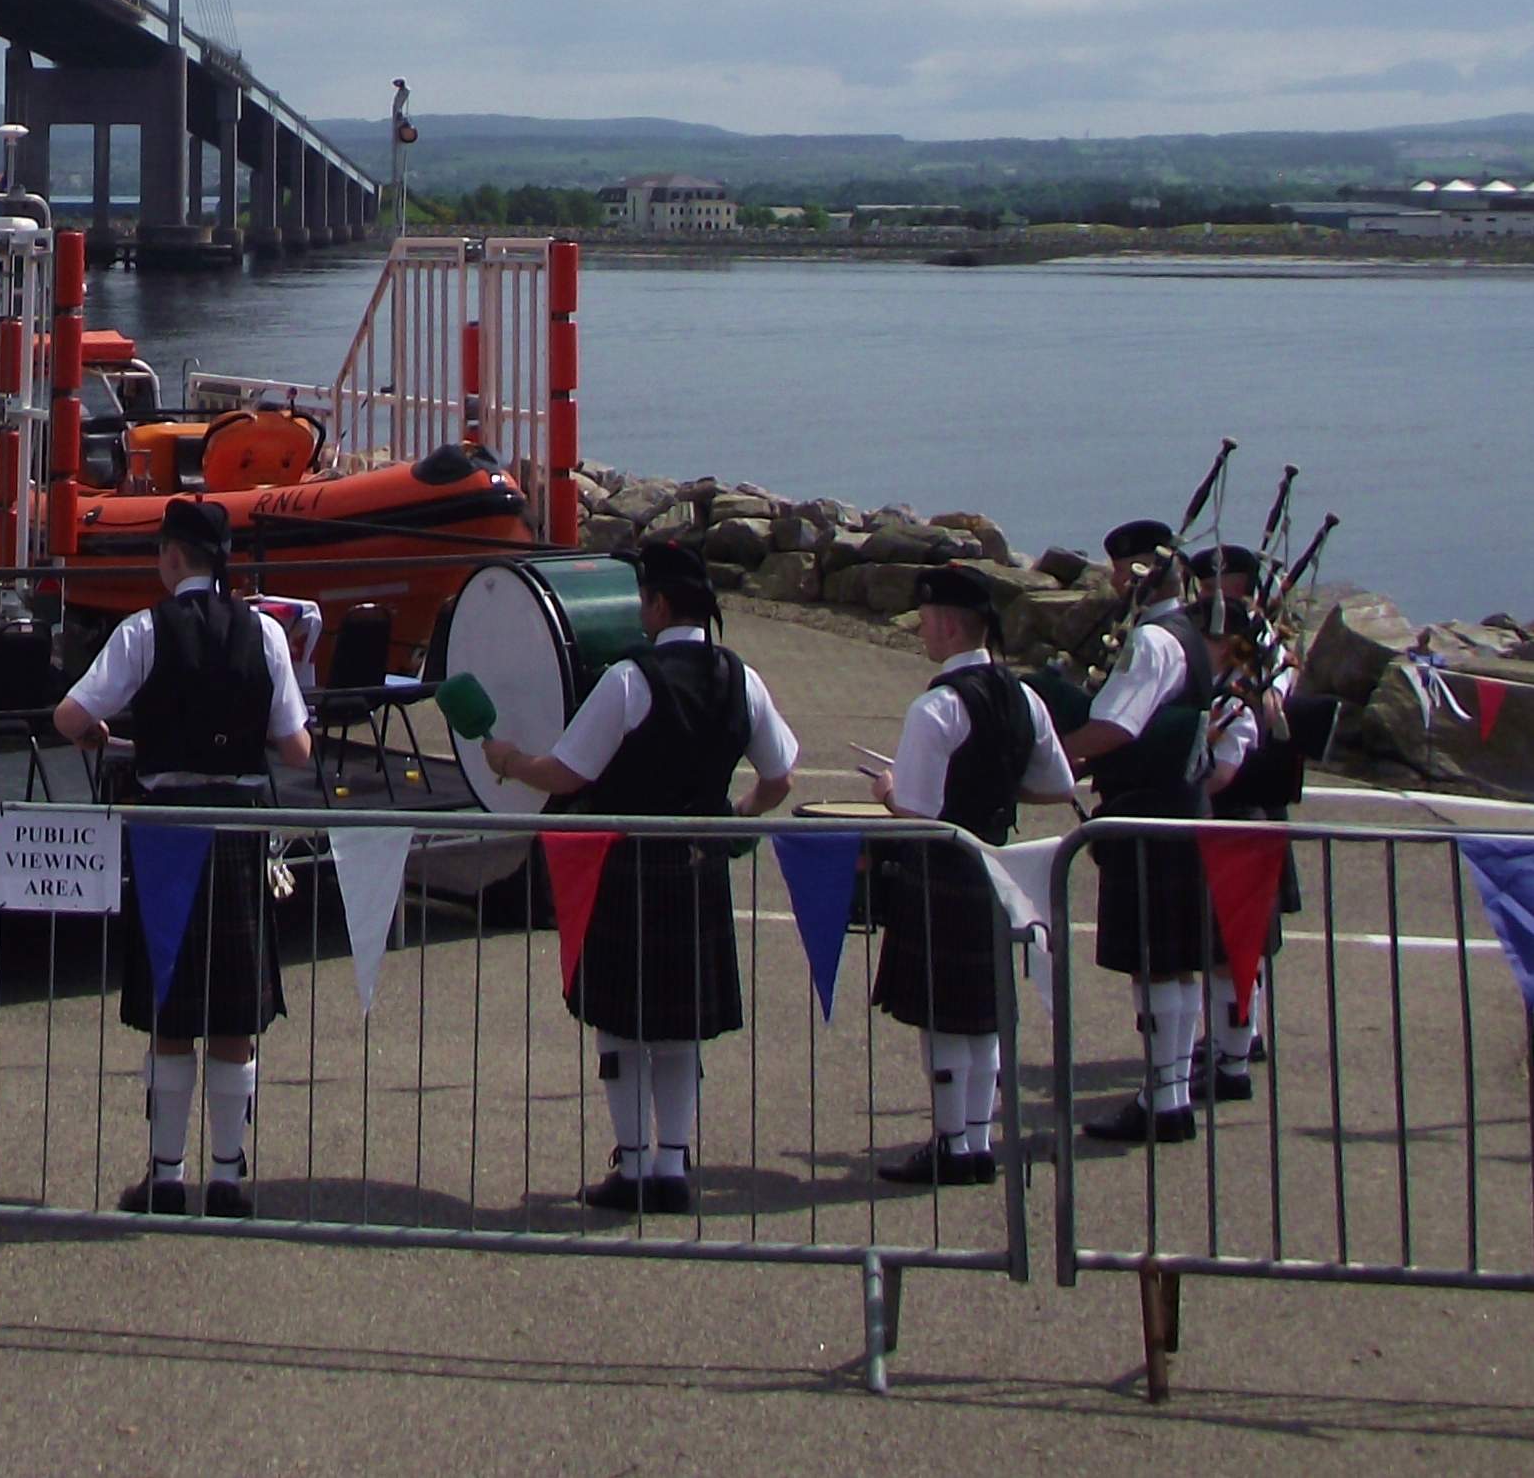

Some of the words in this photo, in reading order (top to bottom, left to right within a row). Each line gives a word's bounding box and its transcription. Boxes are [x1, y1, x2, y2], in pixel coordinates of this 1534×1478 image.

[253, 487, 324, 514] RNLI
[15, 825, 96, 845] PUBLIC
[6, 851, 105, 872] VIEWING
[24, 878, 84, 898] AREA
